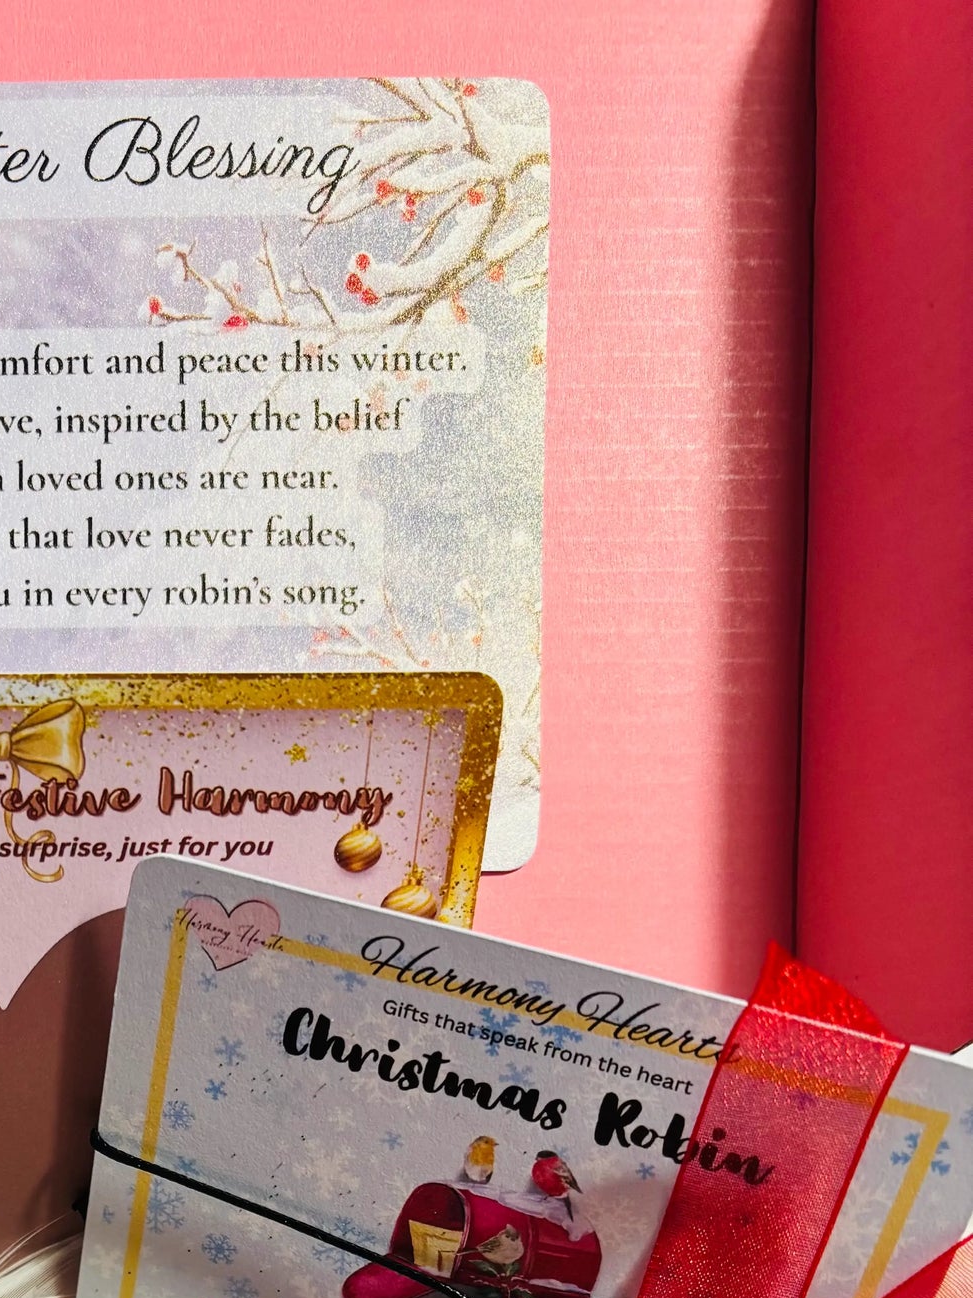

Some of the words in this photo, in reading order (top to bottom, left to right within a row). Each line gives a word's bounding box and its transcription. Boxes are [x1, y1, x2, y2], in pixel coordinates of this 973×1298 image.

[84, 115, 360, 214] Blessing
[106, 342, 165, 374] and
[178, 351, 268, 385] peace
[280, 341, 339, 371] this
[350, 345, 467, 371] winter.
[56, 401, 187, 444] inspired
[200, 400, 232, 443] by
[249, 400, 301, 431] the
[314, 398, 411, 431] belief
[17, 460, 102, 493] loved
[115, 467, 188, 490] ones
[200, 469, 248, 490] are
[262, 467, 338, 490] near.
[8, 517, 73, 550] that
[86, 516, 151, 549] love
[164, 524, 254, 546] never
[266, 515, 356, 552] fades,
[23, 577, 54, 607] in
[65, 584, 150, 615] every
[283, 582, 365, 615] song.
[156, 766, 393, 826] Harmony
[0, 836, 114, 863] surprise,
[116, 836, 172, 862] just
[178, 836, 218, 856] for
[220, 841, 274, 862] you
[361, 936, 568, 1025] Harmony
[382, 999, 429, 1026] Gifts
[435, 1012, 476, 1036] that
[479, 1023, 538, 1055] speak
[542, 1037, 592, 1066] from
[598, 1051, 632, 1077] the
[637, 1063, 694, 1096] heart
[282, 1007, 568, 1132] Christmas
[594, 1091, 777, 1187] Robin
